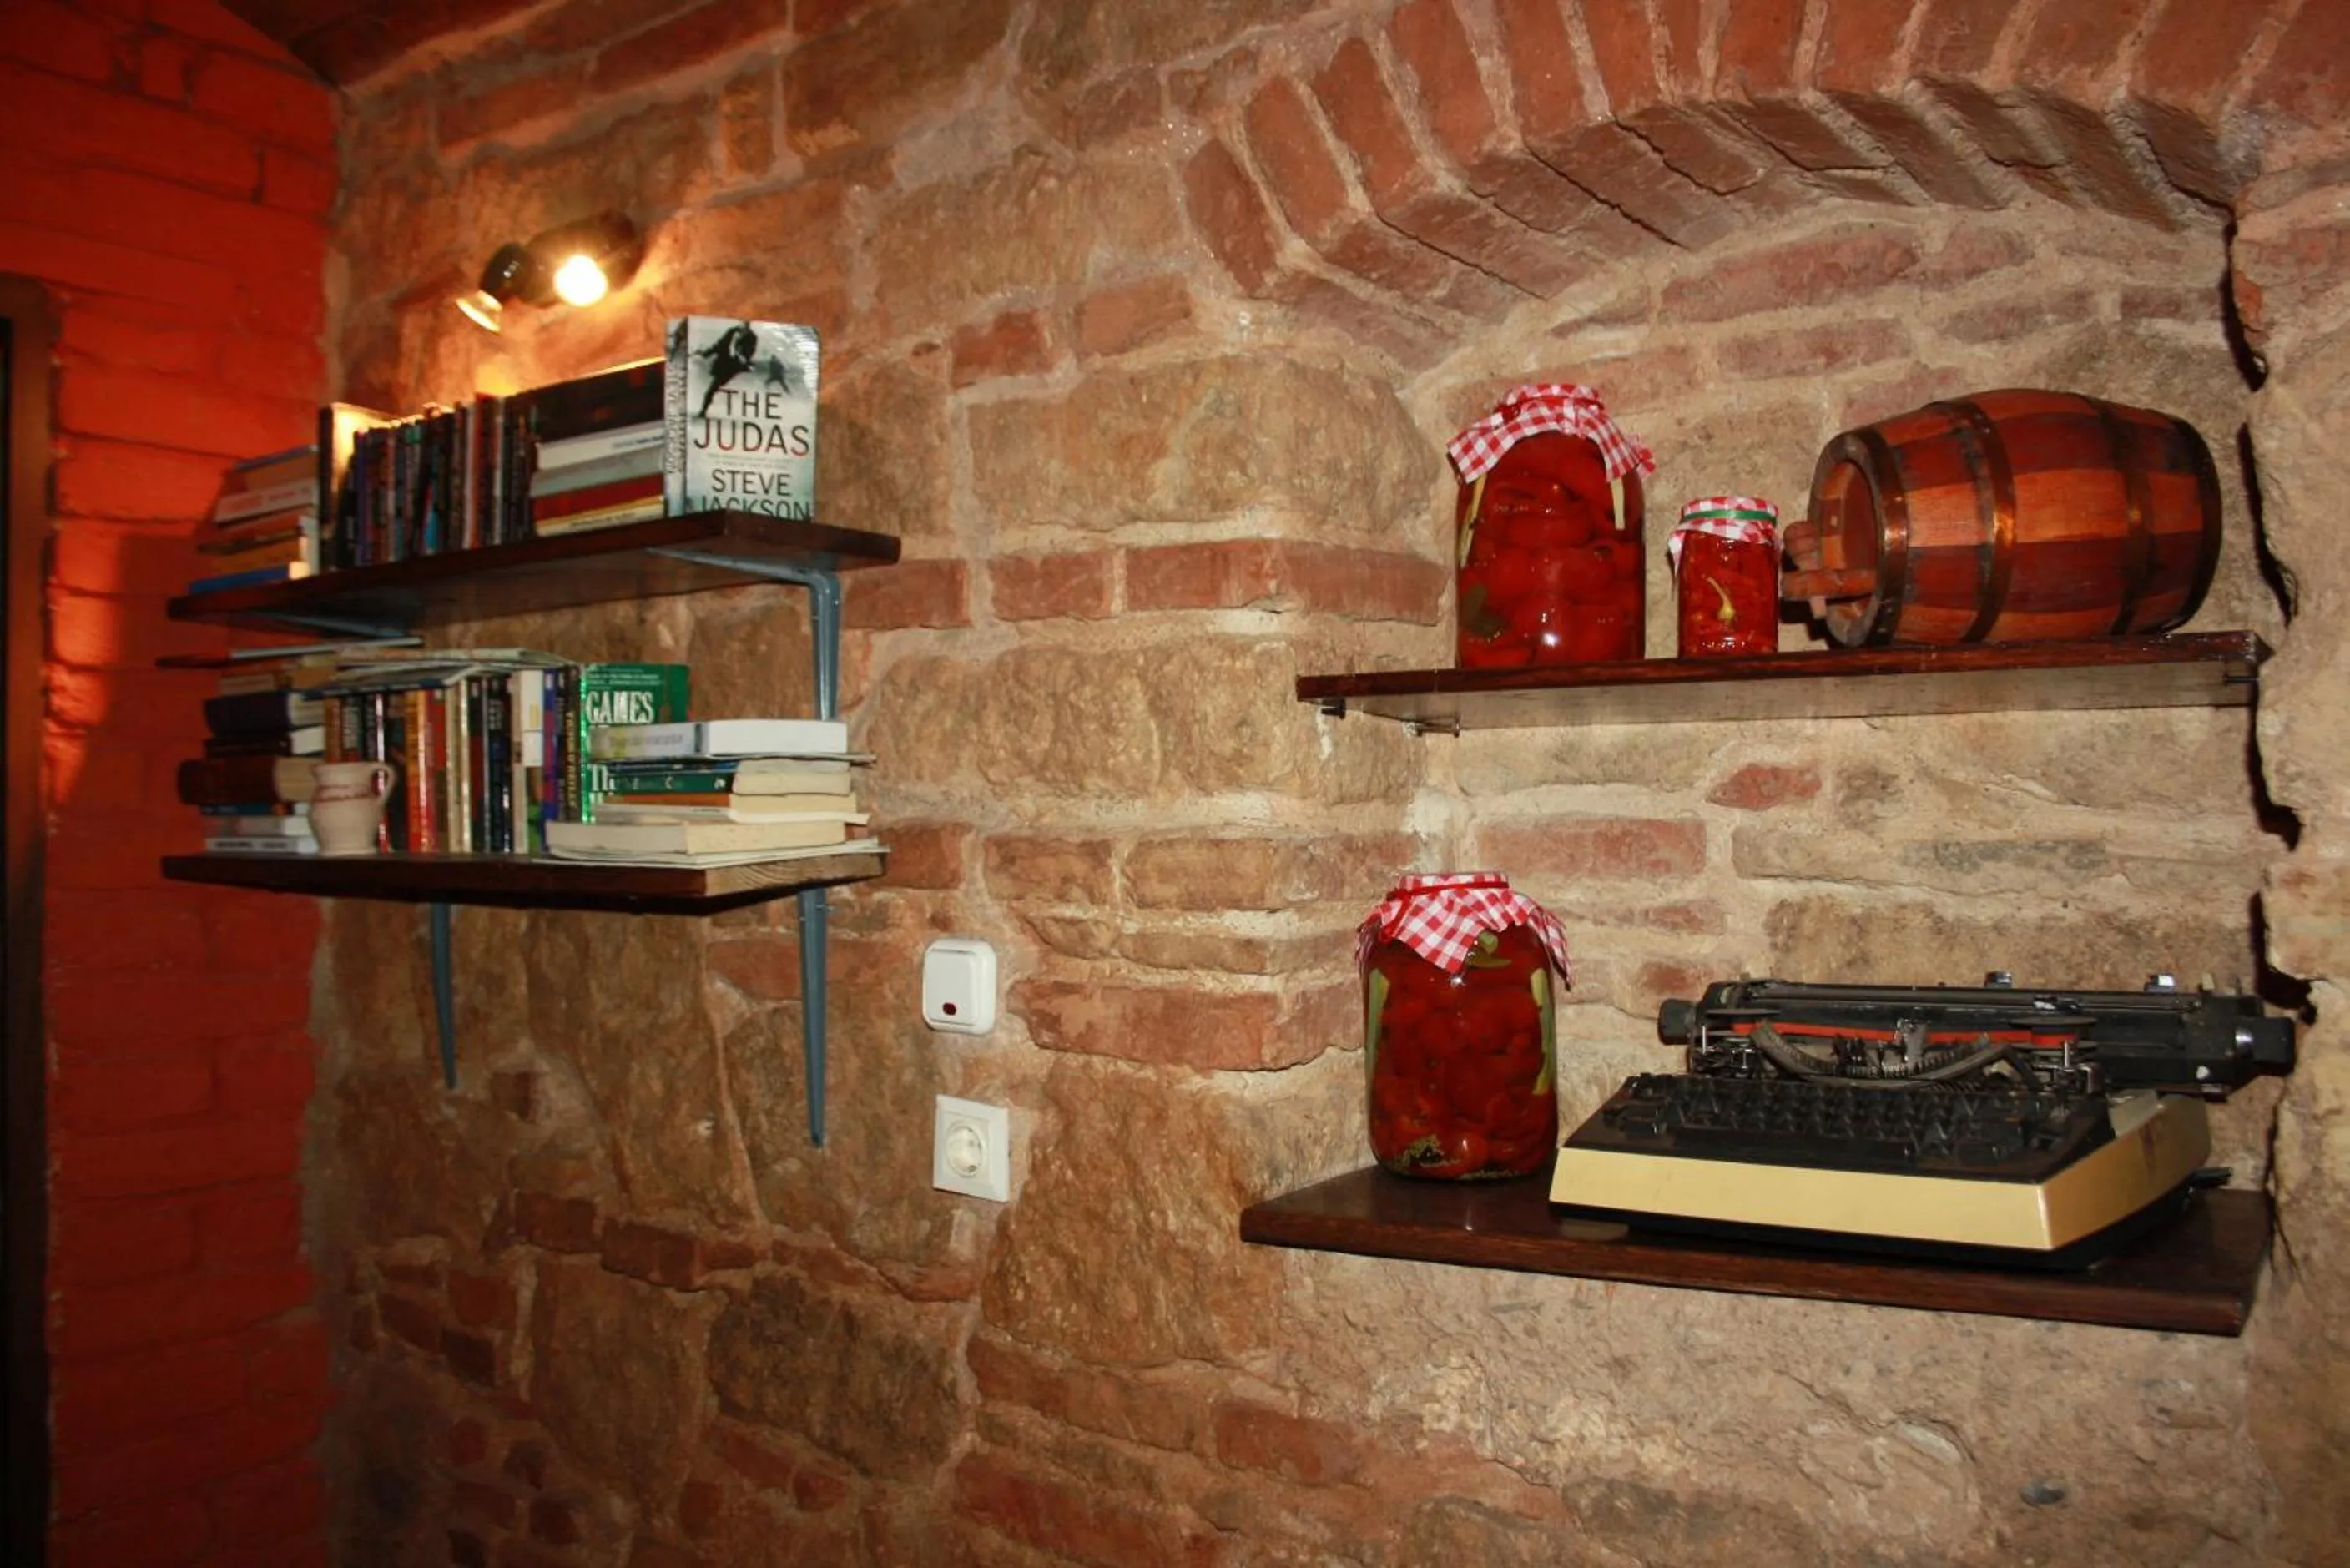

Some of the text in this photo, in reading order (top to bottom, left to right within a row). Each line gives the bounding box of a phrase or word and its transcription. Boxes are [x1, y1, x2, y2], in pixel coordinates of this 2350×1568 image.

[719, 388, 783, 419] THE
[693, 419, 809, 456] JUDAS
[711, 468, 792, 497] STEVE
[586, 690, 655, 725] GAMES
